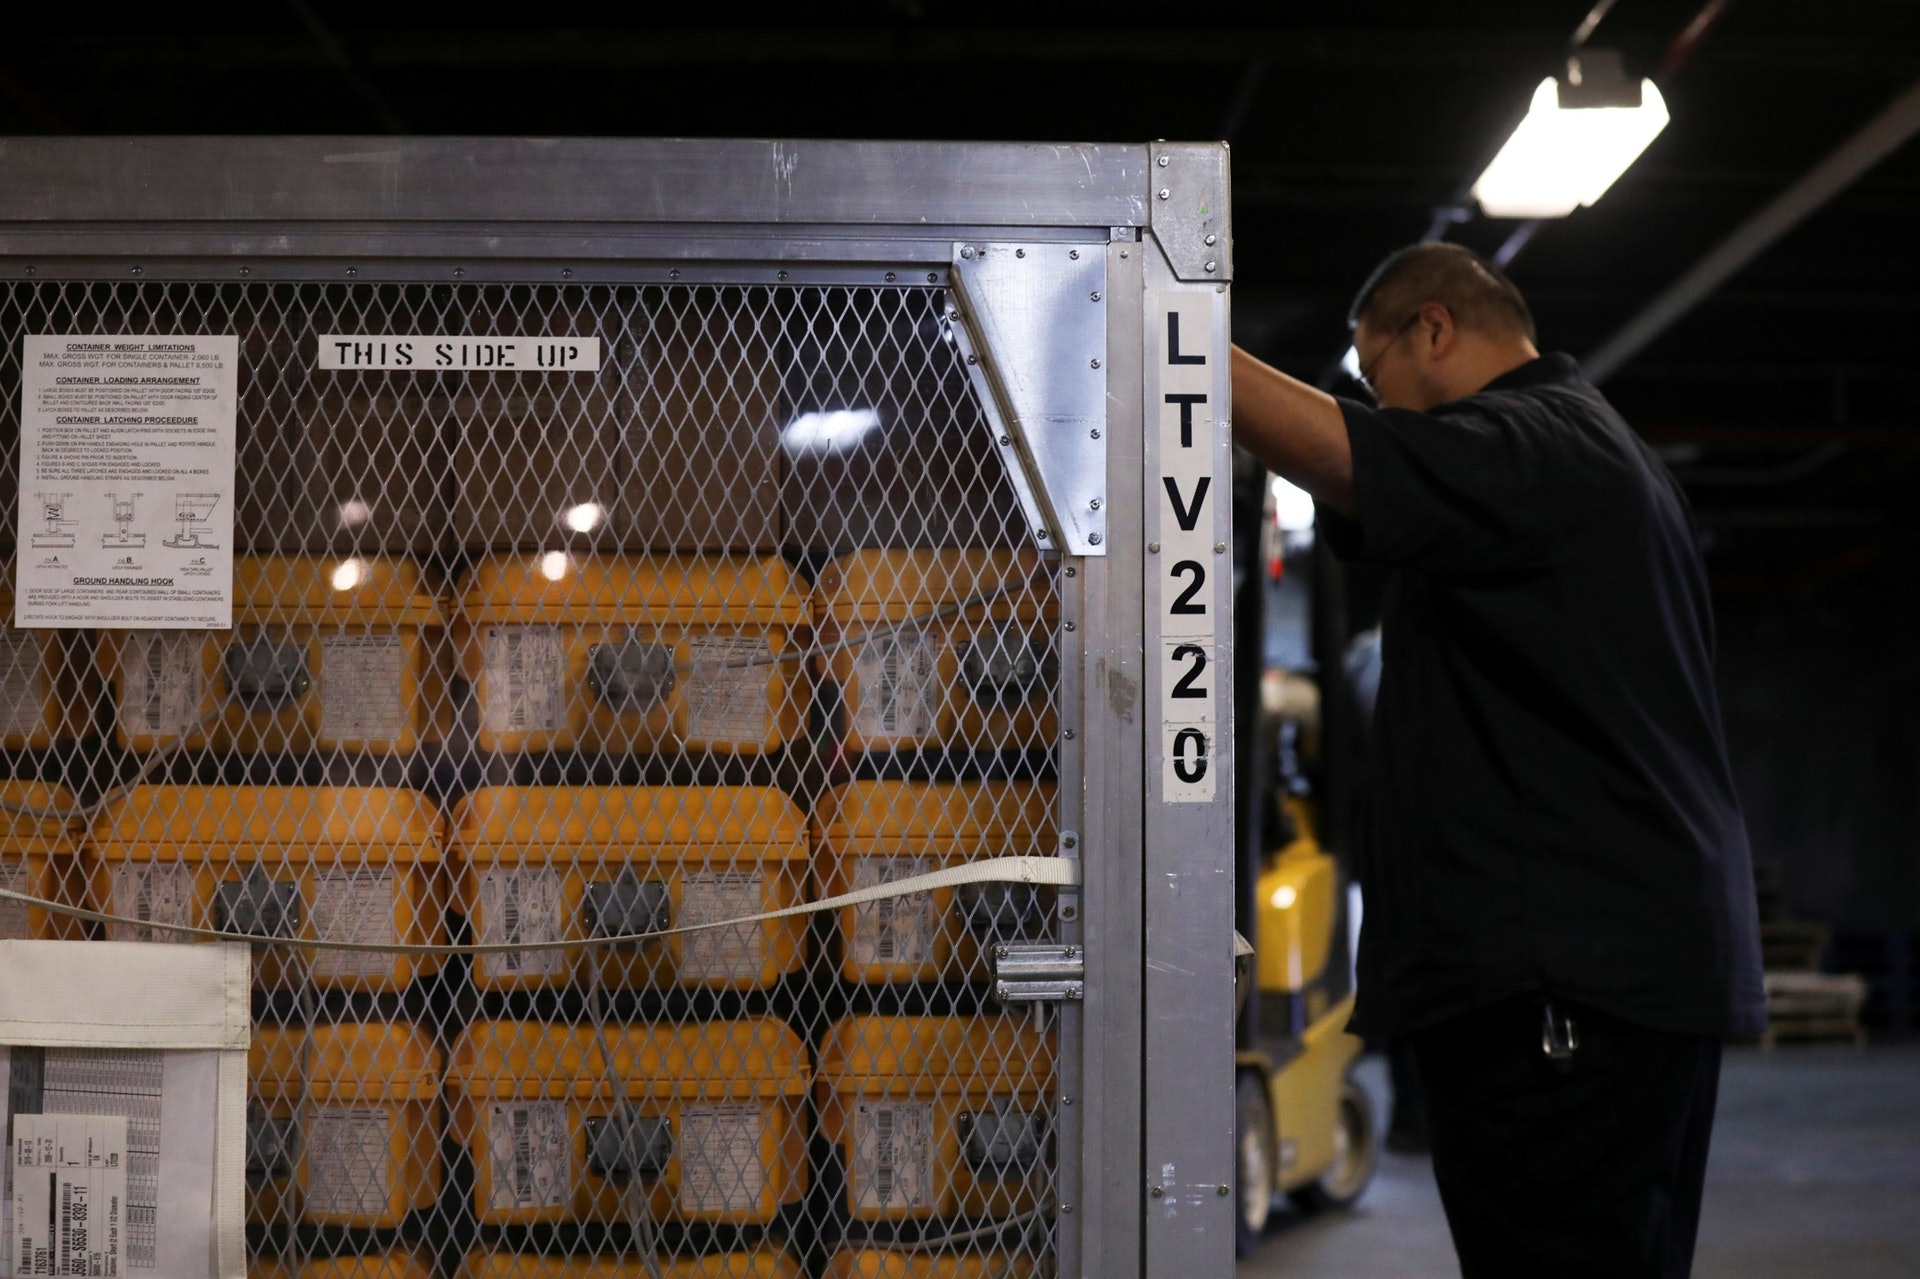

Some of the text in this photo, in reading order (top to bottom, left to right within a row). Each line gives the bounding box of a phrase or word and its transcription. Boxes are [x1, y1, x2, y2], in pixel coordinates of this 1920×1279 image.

[335, 343, 578, 367] THIS SIDE UP
[35, 1248, 47, 1274] T163761
